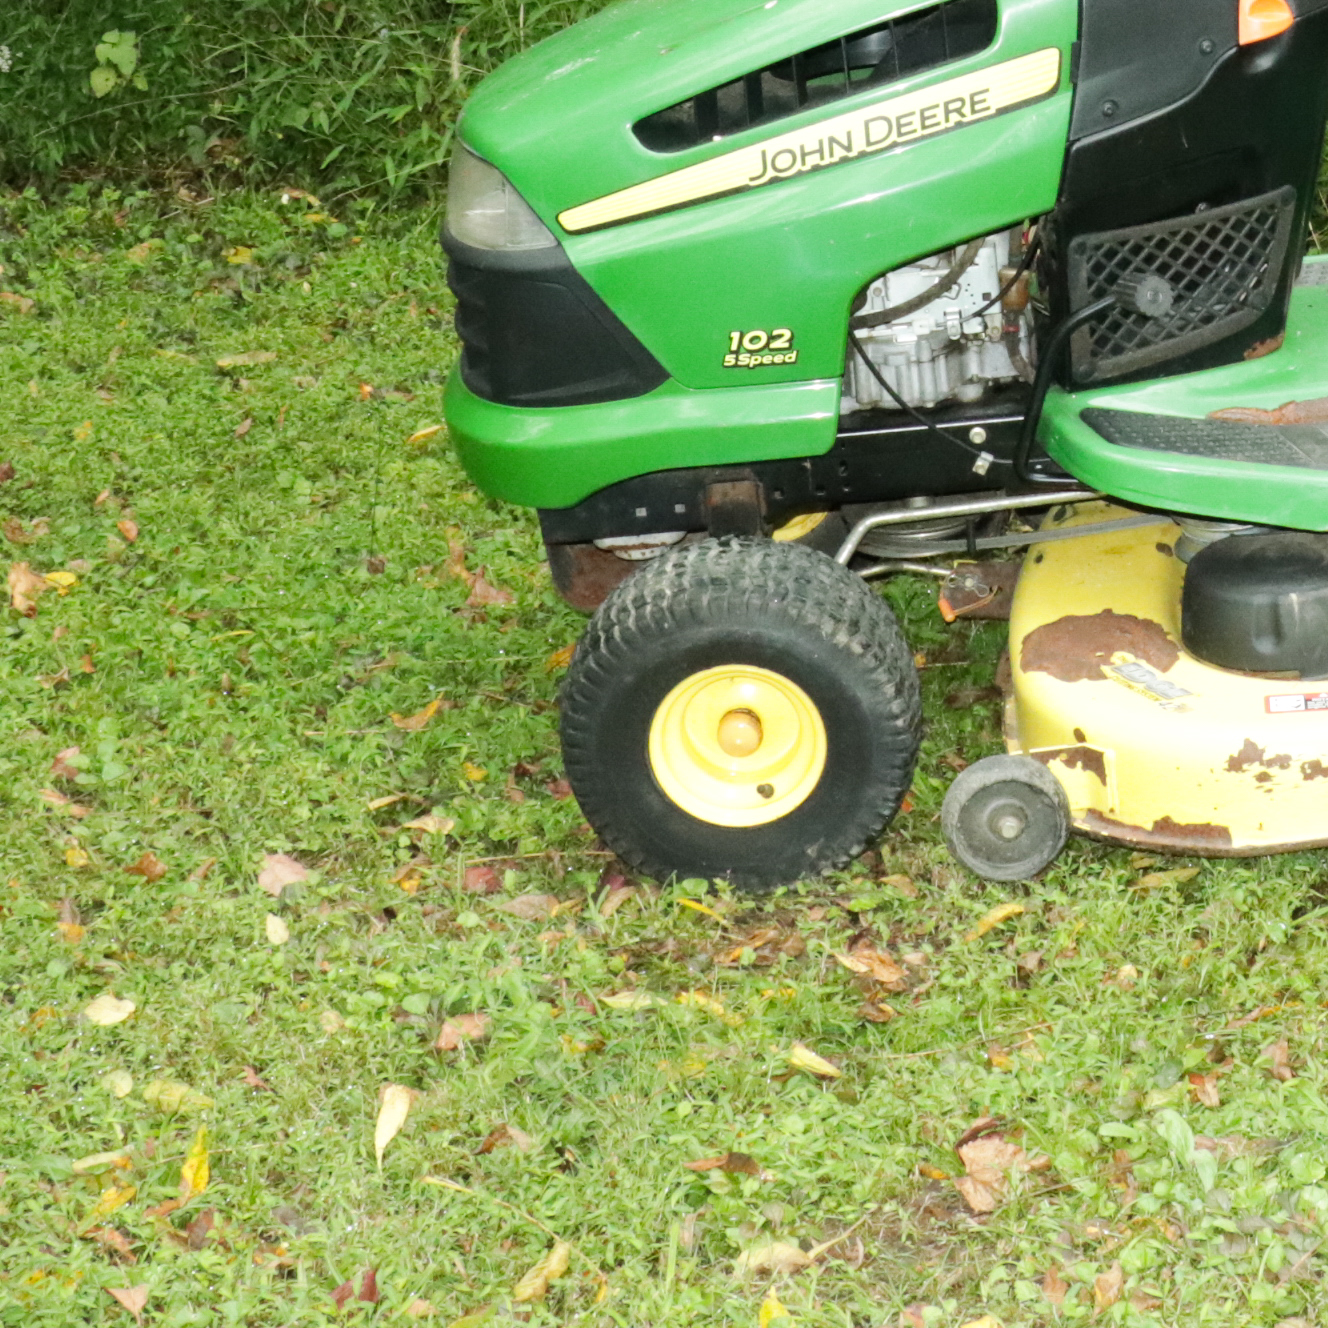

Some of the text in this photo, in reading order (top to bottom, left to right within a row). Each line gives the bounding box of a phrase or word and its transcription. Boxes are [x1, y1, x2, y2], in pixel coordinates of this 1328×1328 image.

[749, 88, 991, 182] JOHN DEERE
[730, 328, 793, 352] 102
